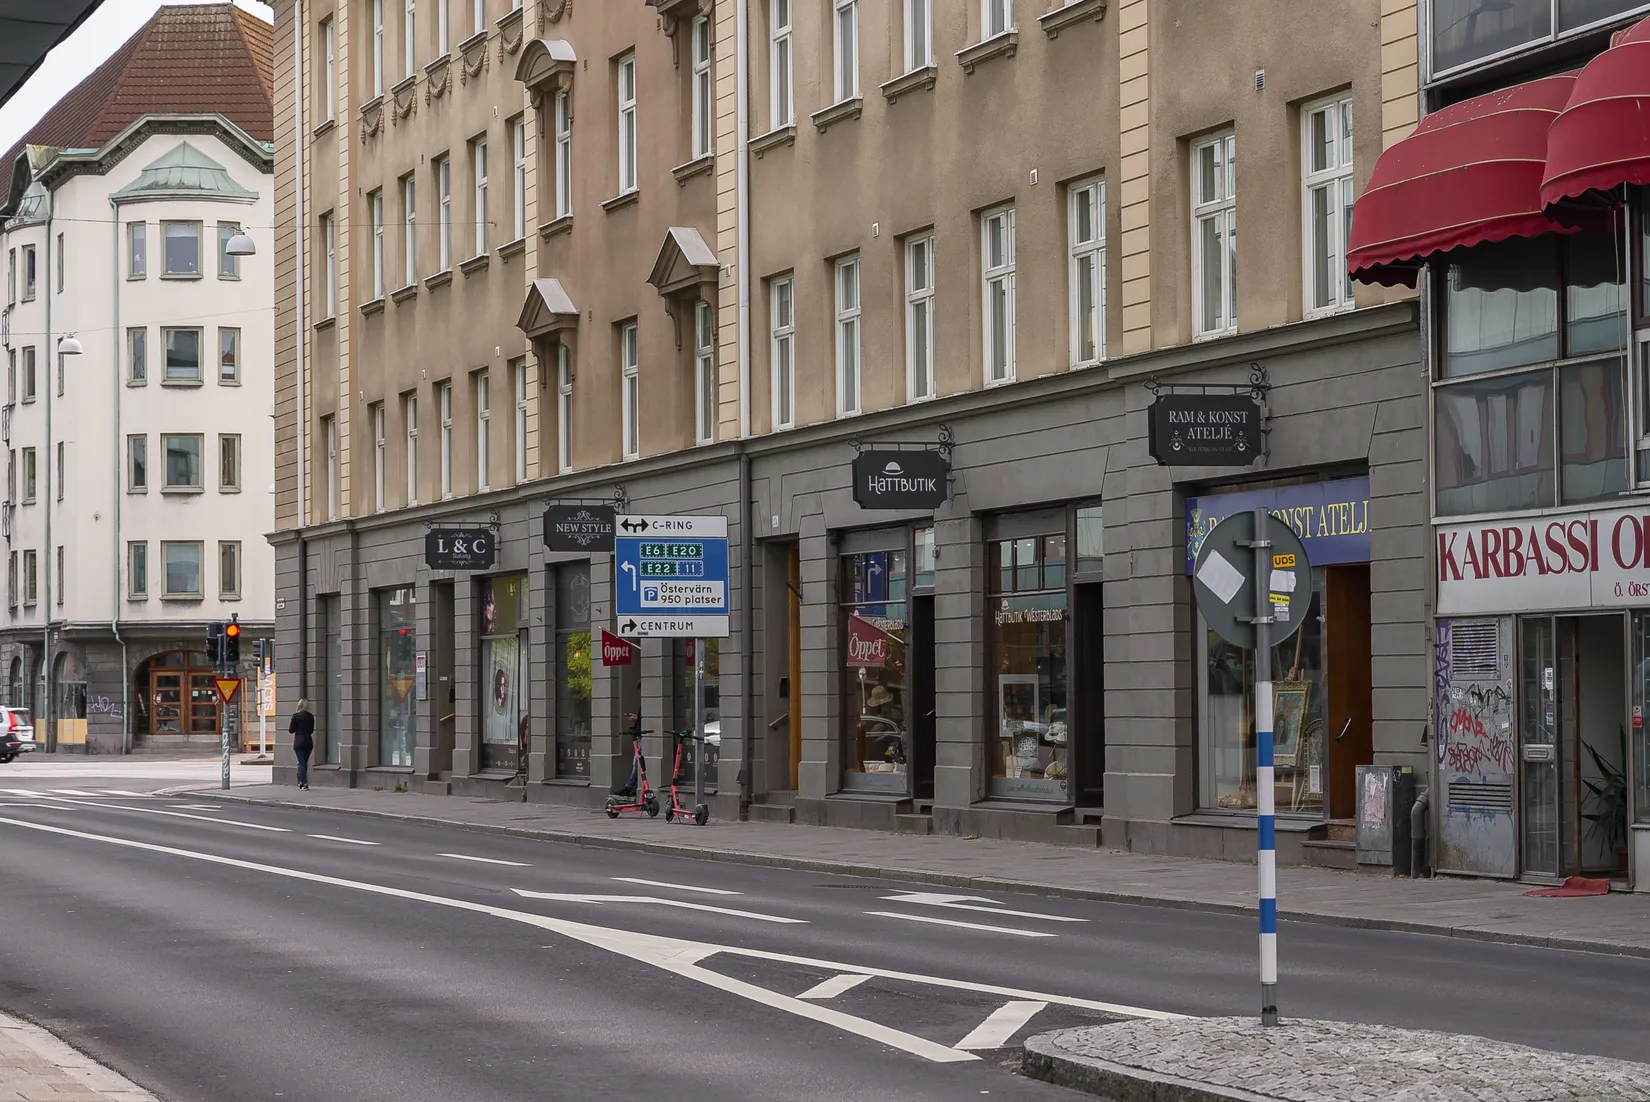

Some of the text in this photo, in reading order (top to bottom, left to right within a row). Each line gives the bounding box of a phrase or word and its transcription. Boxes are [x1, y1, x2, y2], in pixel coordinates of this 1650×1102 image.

[1169, 410, 1248, 423] RAM & KONST
[1187, 424, 1233, 439] ATELJÉ
[1316, 500, 1372, 538] ATELJ
[556, 523, 612, 533] NEW STYLE
[652, 521, 693, 530] C-RING
[437, 539, 486, 554] L & C
[646, 546, 696, 555] E6 E20
[1439, 519, 1599, 581] KARBASSI
[1274, 556, 1294, 565] UDS
[647, 564, 695, 573] E22 11
[660, 582, 712, 593] Östervärn
[1614, 581, 1650, 597] Ö. ÖRS
[660, 594, 721, 606] 950 platser
[640, 621, 694, 631] CENTRUM
[604, 642, 629, 661] Öppet
[850, 632, 885, 662] Öppet
